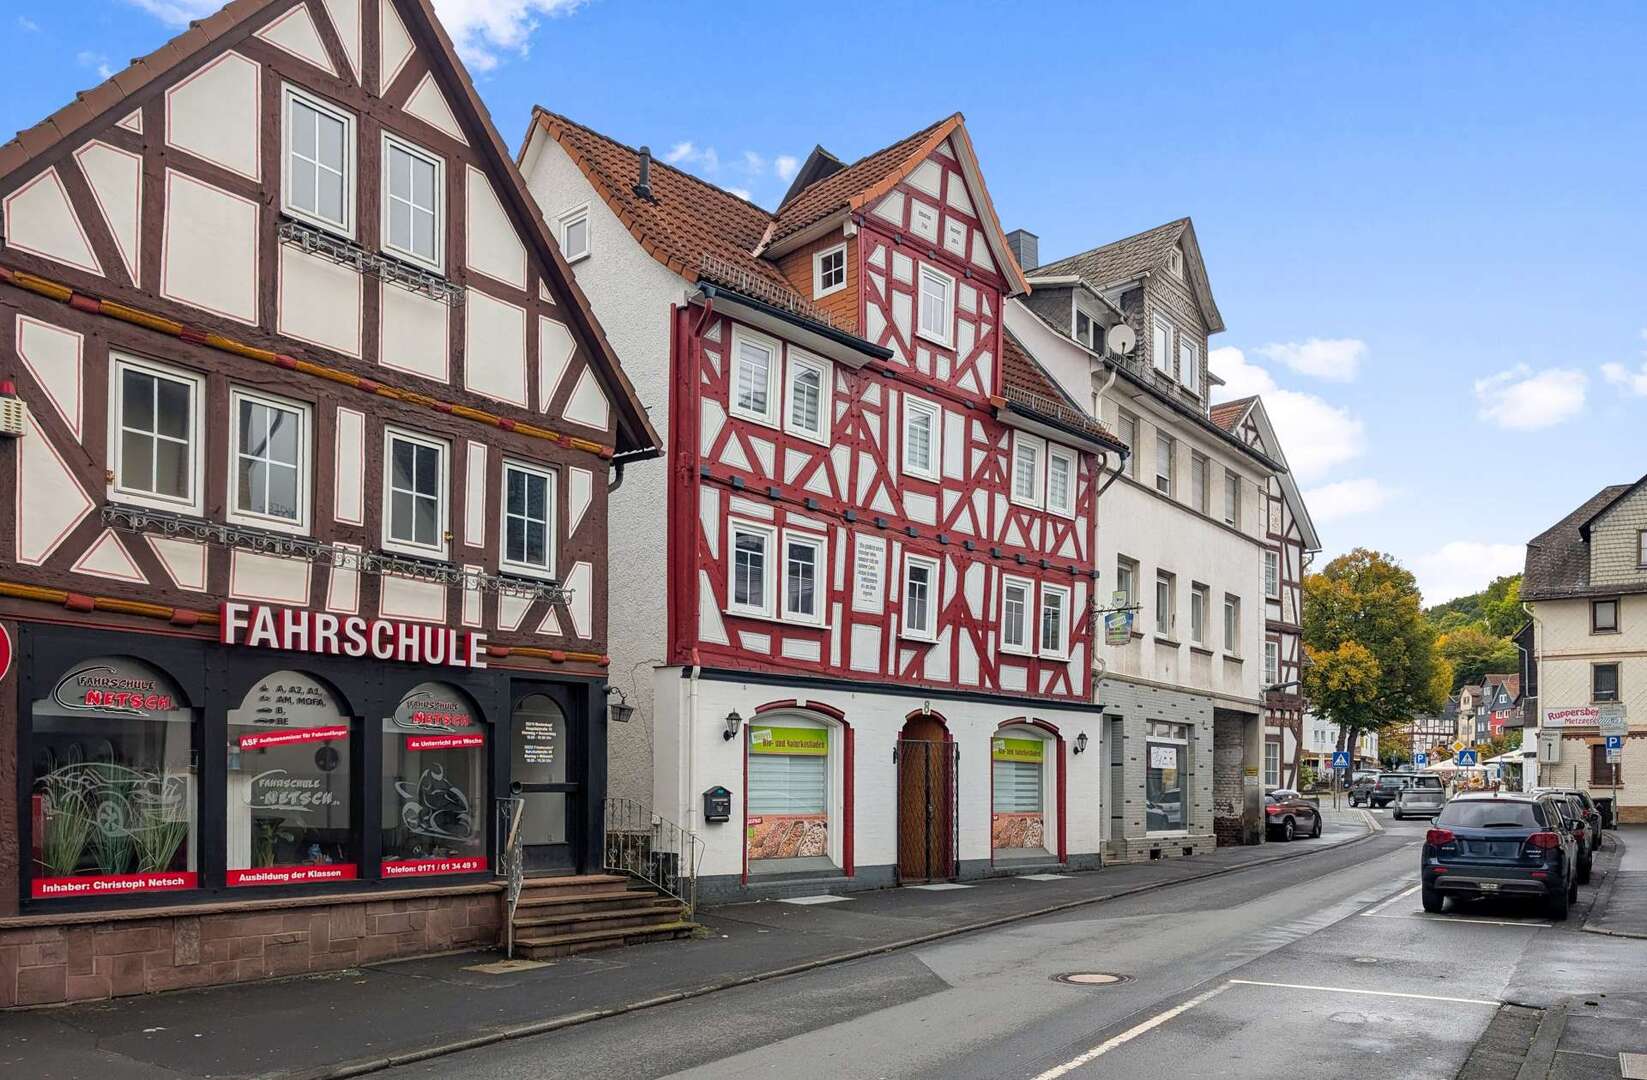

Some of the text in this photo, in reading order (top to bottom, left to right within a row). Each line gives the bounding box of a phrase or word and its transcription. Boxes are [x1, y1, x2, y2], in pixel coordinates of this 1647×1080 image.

[222, 602, 488, 669] FAHRSCHULE
[78, 676, 156, 690] FAHRSCHULE
[84, 689, 172, 711] NETSCH
[406, 700, 459, 710] FAHRSCHULE
[923, 700, 930, 714] 8
[412, 711, 472, 727] NETSCH
[241, 738, 259, 746] ASF
[420, 739, 452, 747] Unterricht
[1609, 737, 1618, 748] P
[259, 779, 321, 788] FAHRSCHULE
[263, 790, 333, 806] NETSCH
[417, 864, 435, 872] 0171
[239, 869, 342, 882] Ausbildung der Klassen
[42, 877, 184, 893] Inhaber: Christoph Netsch
